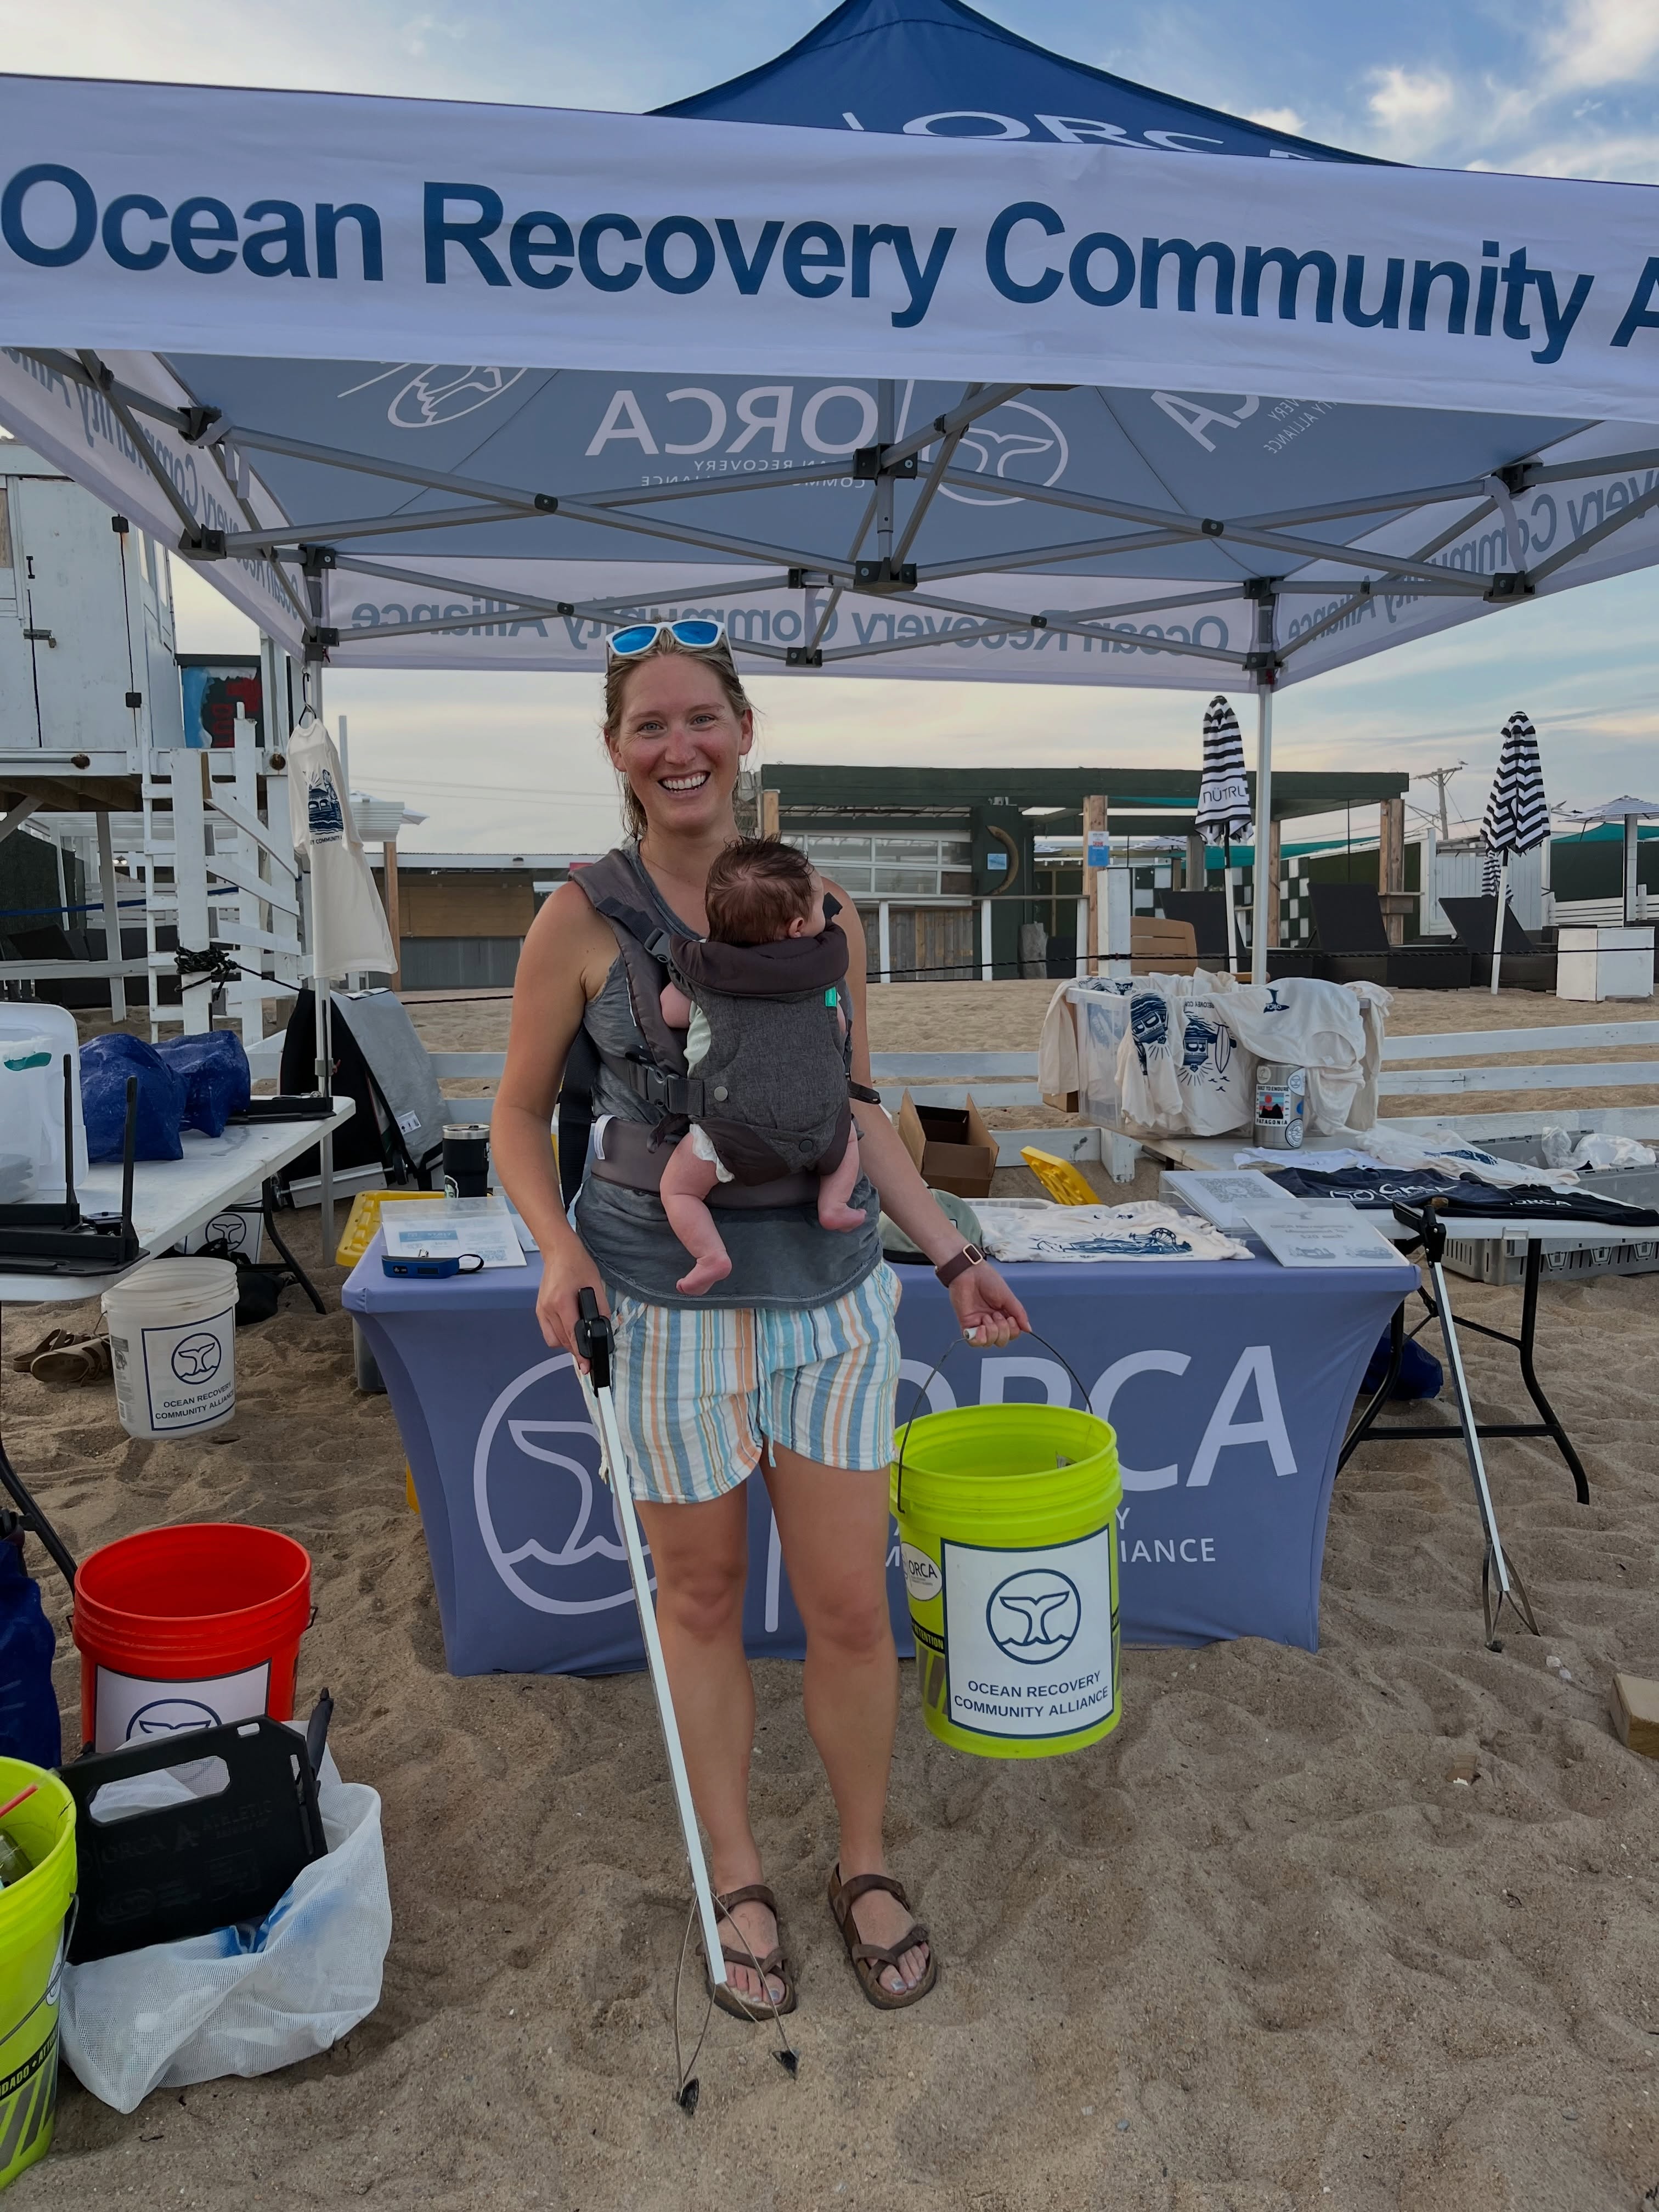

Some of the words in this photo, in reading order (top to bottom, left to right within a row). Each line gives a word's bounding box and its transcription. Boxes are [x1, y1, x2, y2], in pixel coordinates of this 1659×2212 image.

[1, 163, 383, 281] Ocean
[424, 181, 956, 328] Recovery
[986, 201, 1594, 364] Community
[155, 1404, 207, 1419] COMMUNITY
[209, 1389, 234, 1409] ALLIANCE
[163, 1397, 195, 1408] OCEAN
[197, 1381, 232, 1402] RECOVERY
[1120, 1538, 1216, 1563] IANCE
[909, 1560, 938, 1578] ORCA
[968, 1680, 1022, 1697] OCEAN
[1027, 1671, 1101, 1697] RECOVERY
[954, 1695, 1044, 1717] COMMUNITY
[1049, 1686, 1108, 1716] ALLIANCE
[1, 2065, 30, 2096] DADO
